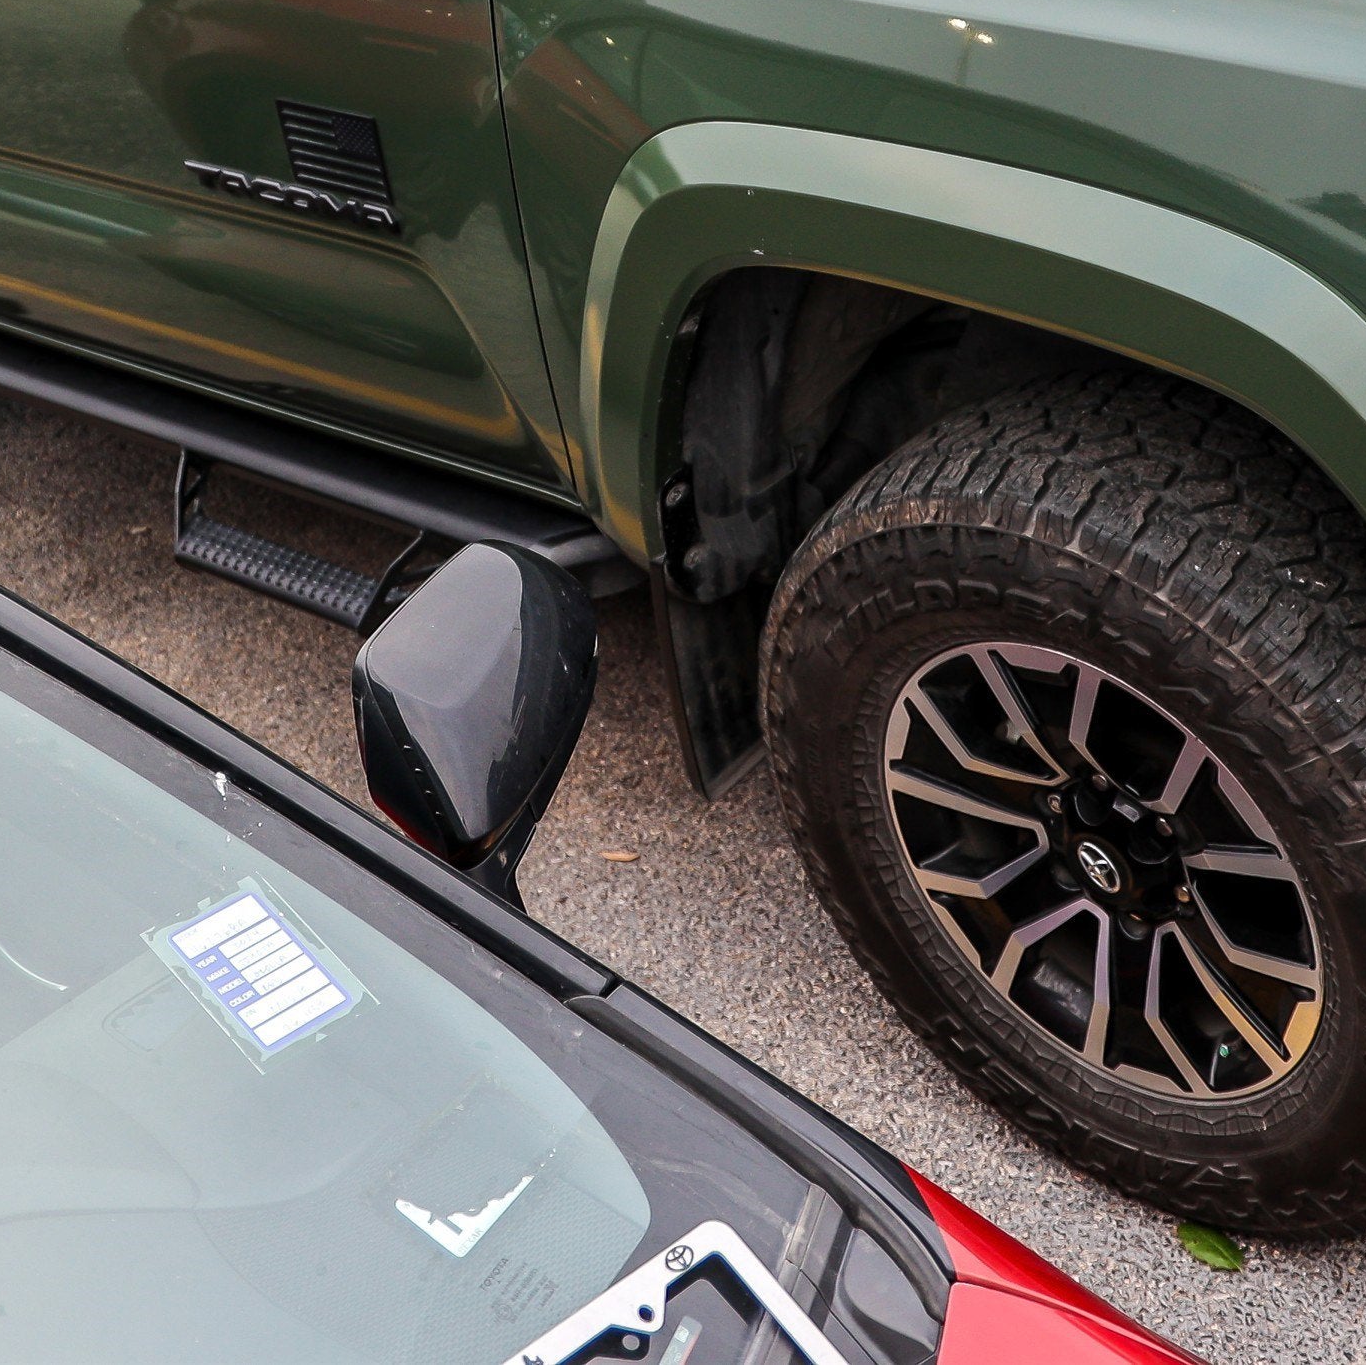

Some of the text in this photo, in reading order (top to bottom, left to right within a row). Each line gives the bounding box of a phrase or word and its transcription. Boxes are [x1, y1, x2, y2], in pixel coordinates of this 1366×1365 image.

[183, 158, 402, 235] TACOMA
[195, 954, 218, 969] YEAR
[206, 966, 231, 983] MAKE
[217, 977, 246, 995] MODEL
[228, 989, 257, 1008] COLOR
[479, 1258, 509, 1291] TOYOTA
